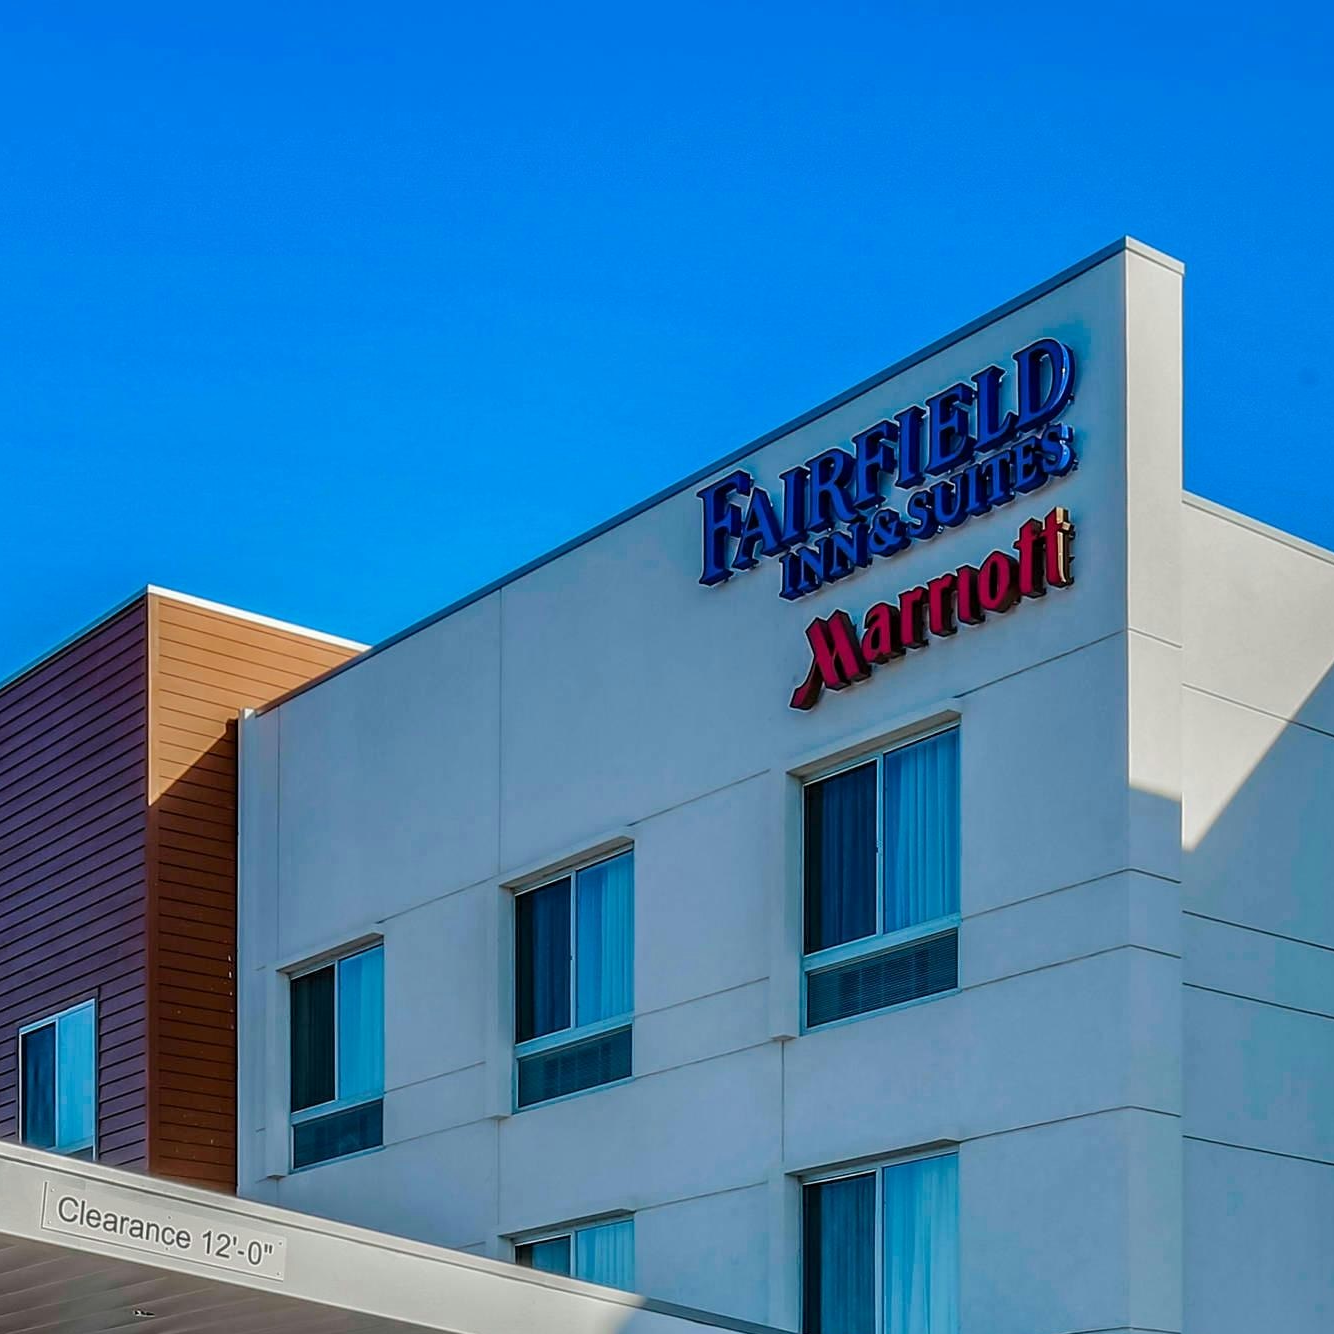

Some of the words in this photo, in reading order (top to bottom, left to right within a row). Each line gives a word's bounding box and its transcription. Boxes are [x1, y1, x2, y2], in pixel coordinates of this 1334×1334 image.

[696, 337, 1075, 587] FAIRFIELD
[789, 506, 1075, 710] Marriott
[58, 1196, 191, 1249] Clearance
[202, 1230, 273, 1266] 12'-0"
